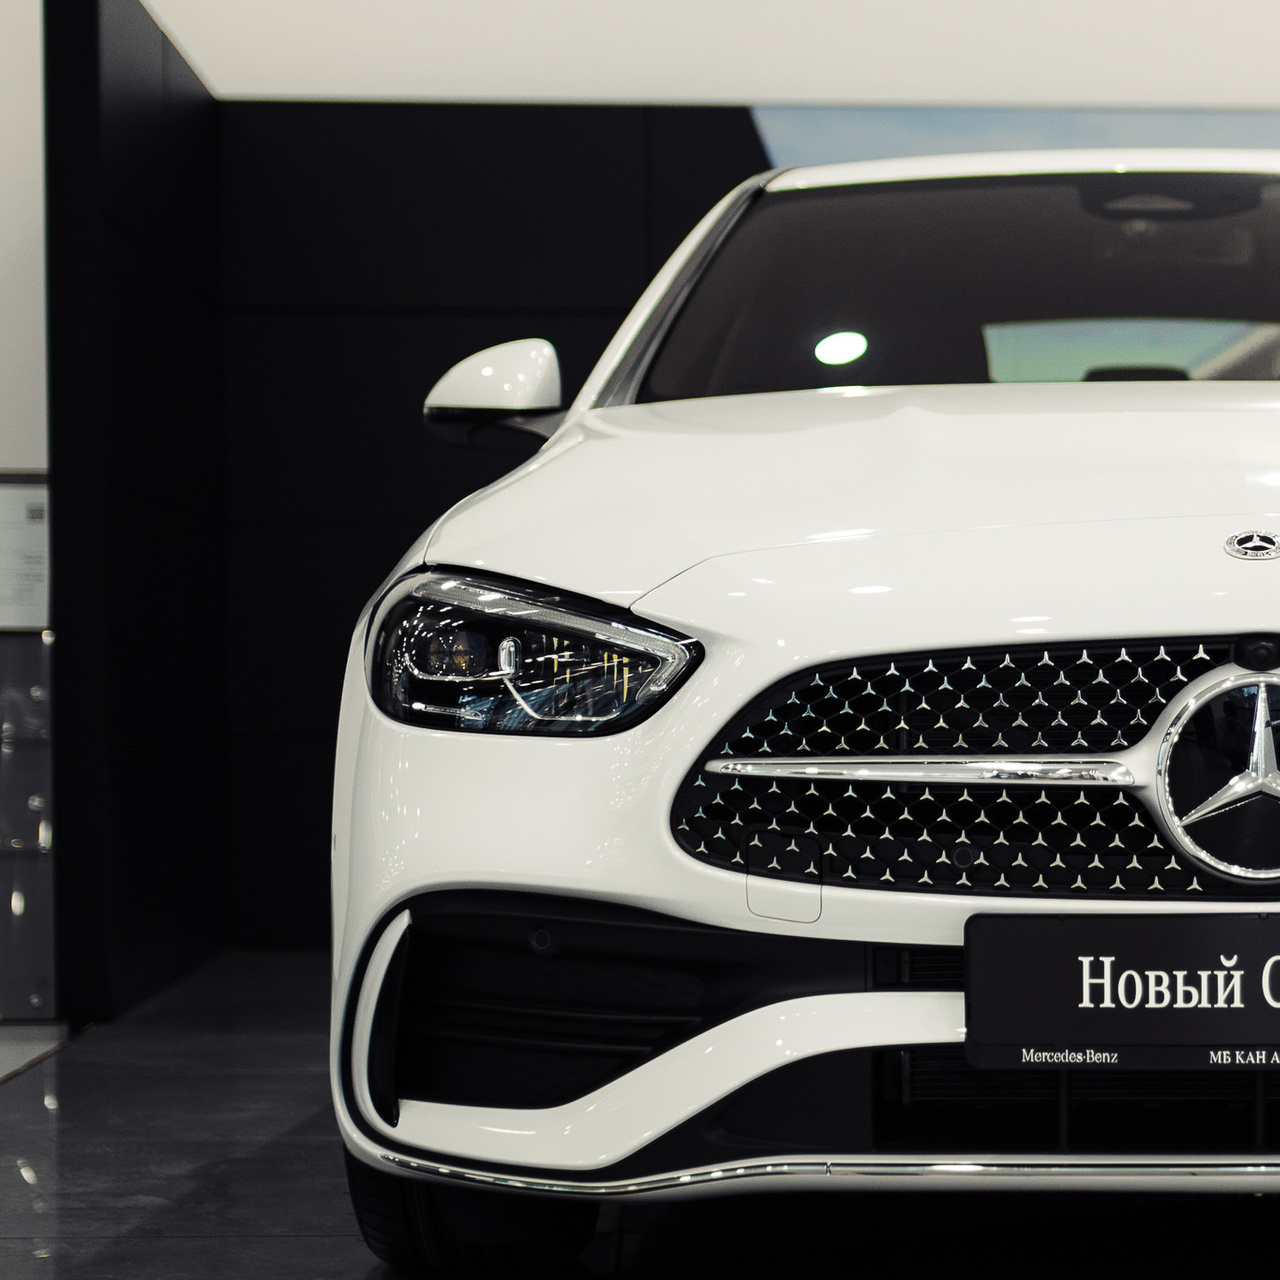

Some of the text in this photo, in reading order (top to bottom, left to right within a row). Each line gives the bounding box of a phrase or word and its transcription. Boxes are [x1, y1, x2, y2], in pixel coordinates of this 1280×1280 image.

[1078, 955, 1244, 1008] Новый
[1209, 1050, 1232, 1064] МБ
[1235, 1050, 1267, 1064] КАН
